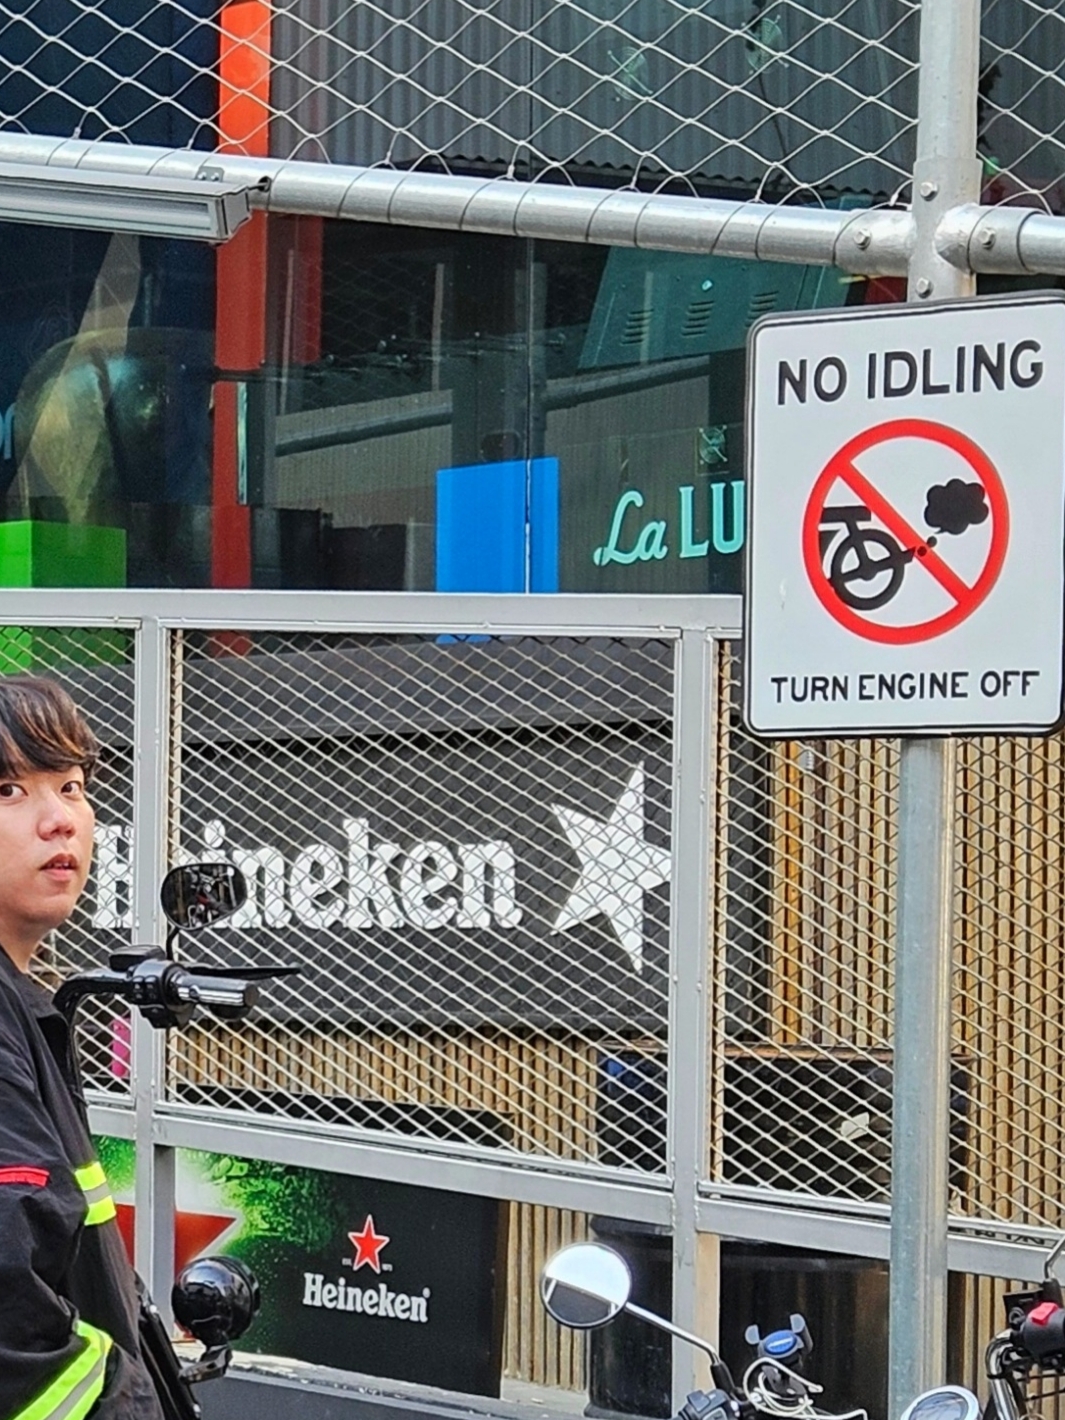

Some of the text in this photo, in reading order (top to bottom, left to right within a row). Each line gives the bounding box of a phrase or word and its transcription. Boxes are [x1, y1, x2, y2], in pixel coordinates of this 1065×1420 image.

[777, 339, 1044, 406] NO IDLING
[593, 480, 745, 566] La LU
[770, 670, 1041, 703] TURN ENGINE OFF
[92, 817, 524, 930] Hineken
[302, 1272, 431, 1323] Heineken
